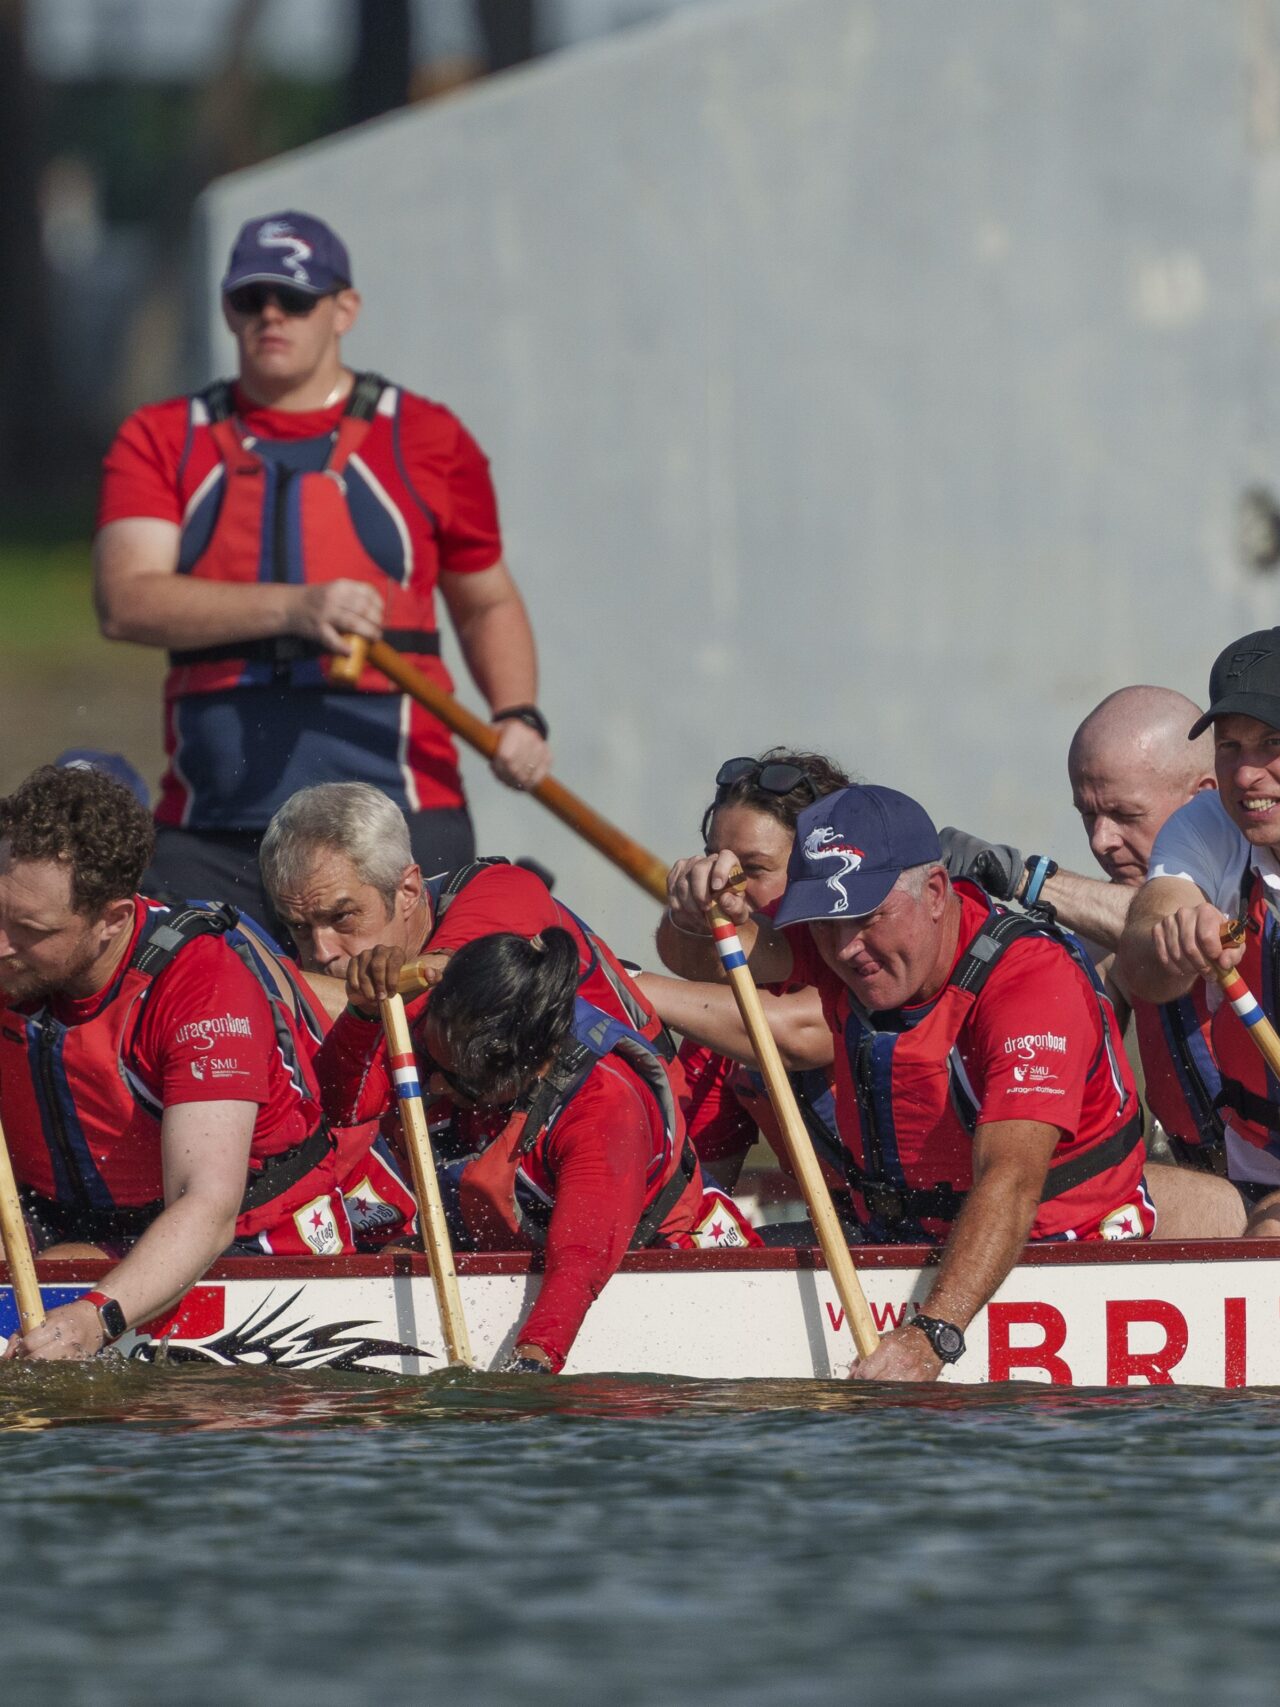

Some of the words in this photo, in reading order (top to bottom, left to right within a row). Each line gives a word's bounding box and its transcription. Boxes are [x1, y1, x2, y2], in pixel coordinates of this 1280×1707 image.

[1004, 1031, 1067, 1059] dragonboat
[210, 1058, 238, 1070] SMU
[1029, 1065, 1049, 1075] SMU
